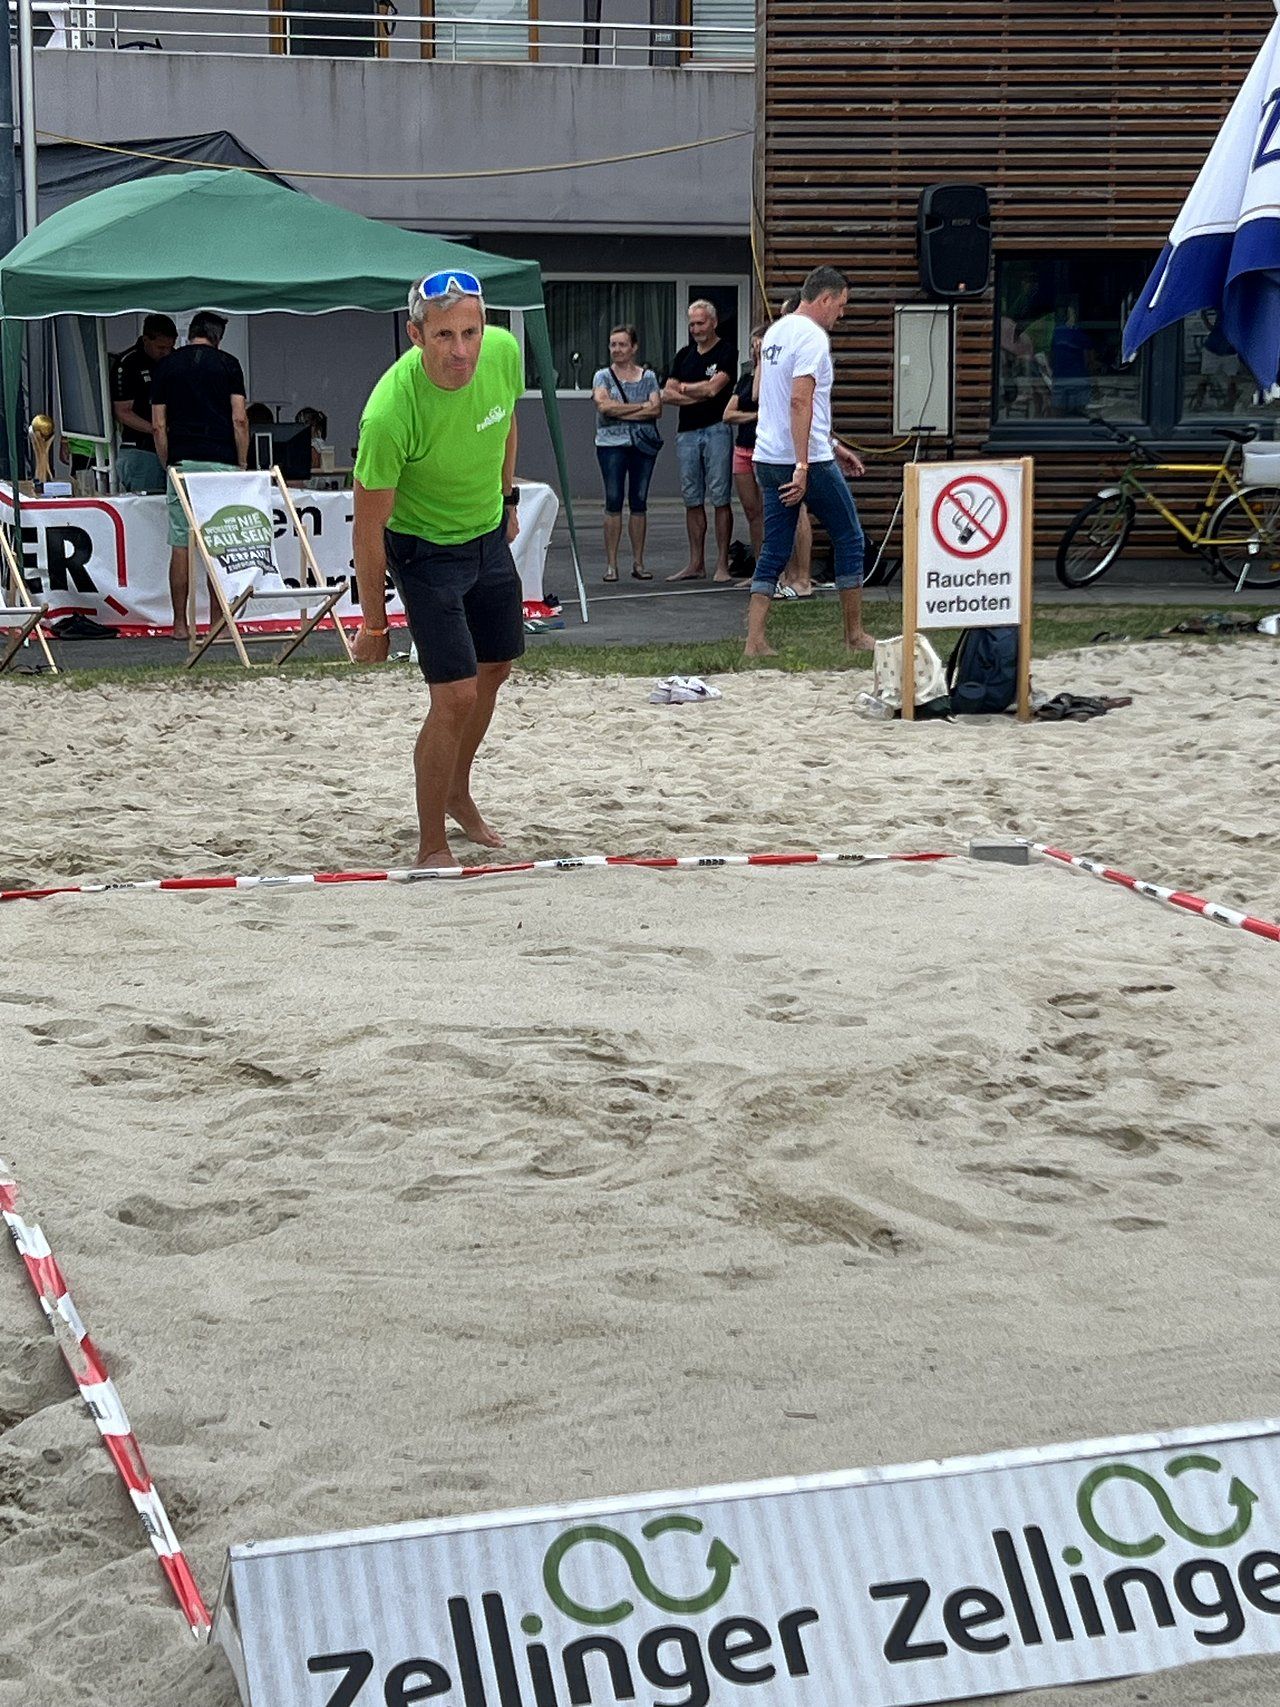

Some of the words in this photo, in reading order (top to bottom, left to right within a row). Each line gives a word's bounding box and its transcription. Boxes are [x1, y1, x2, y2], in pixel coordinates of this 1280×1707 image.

[237, 512, 262, 528] NIE
[203, 533, 243, 548] FAUL
[4, 526, 98, 594] ER
[926, 569, 1011, 588] Rauchen
[925, 595, 1010, 613] verboten
[307, 1590, 819, 1707] zellinger
